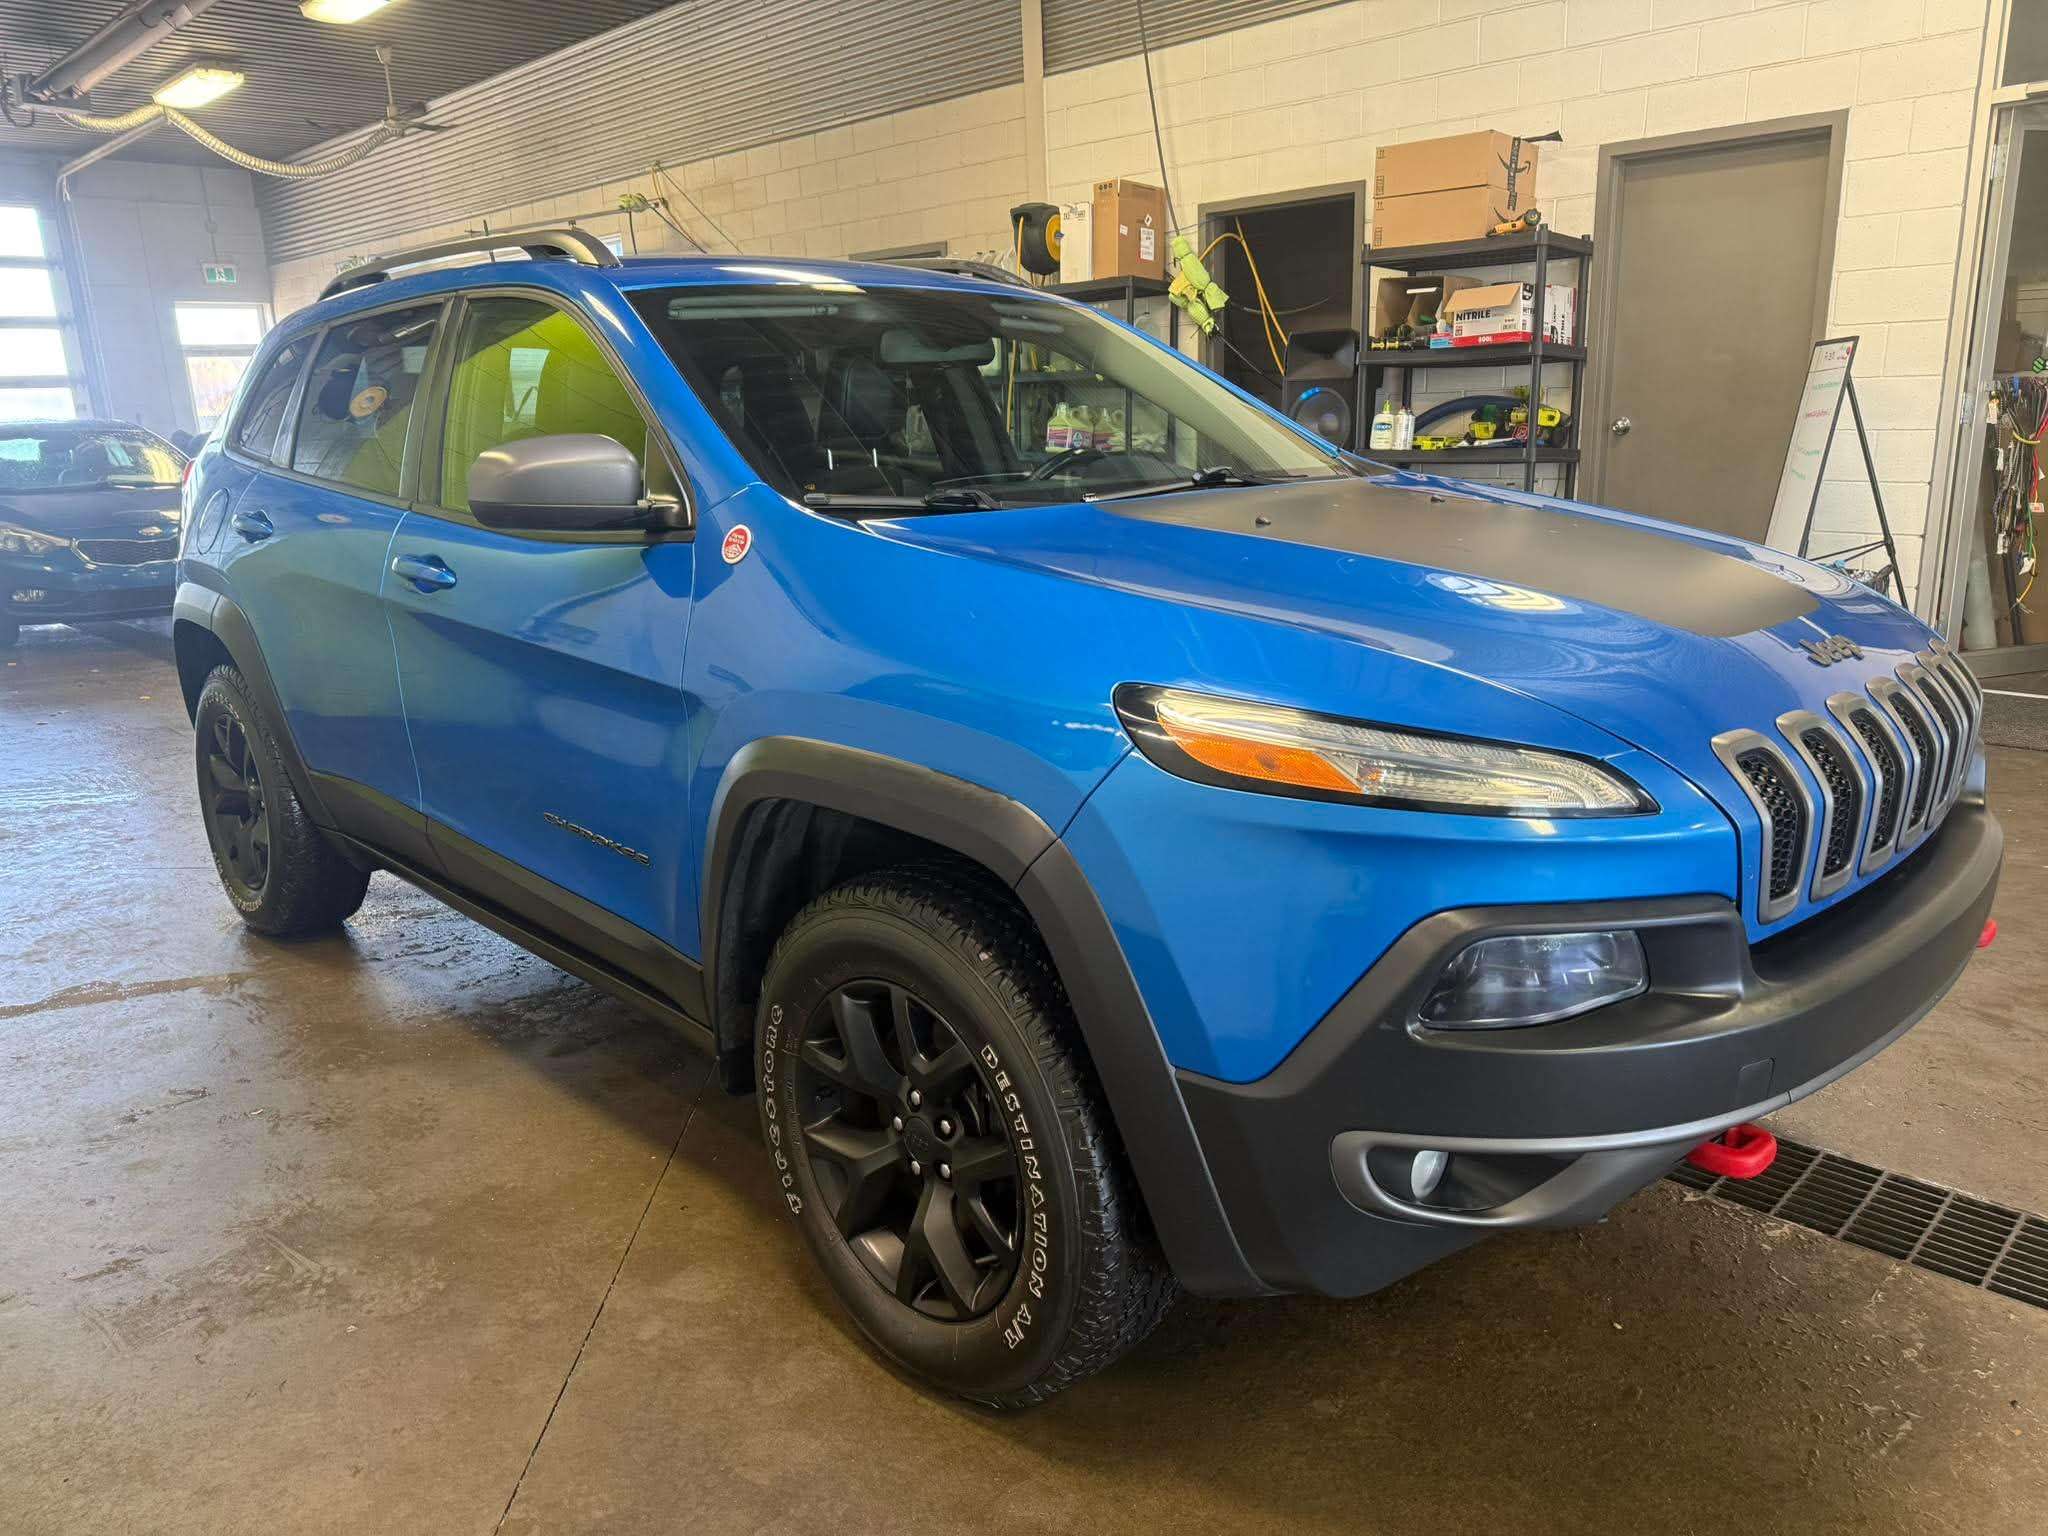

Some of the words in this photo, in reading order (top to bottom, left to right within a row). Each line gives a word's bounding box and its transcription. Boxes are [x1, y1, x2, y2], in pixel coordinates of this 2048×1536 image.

[1456, 309, 1491, 321] NITRILE
[1799, 634, 1864, 667] Jeep
[543, 811, 650, 866] CHEROKEE
[981, 1044, 1047, 1299] DESTINATION
[1004, 1303, 1032, 1349] A/T
